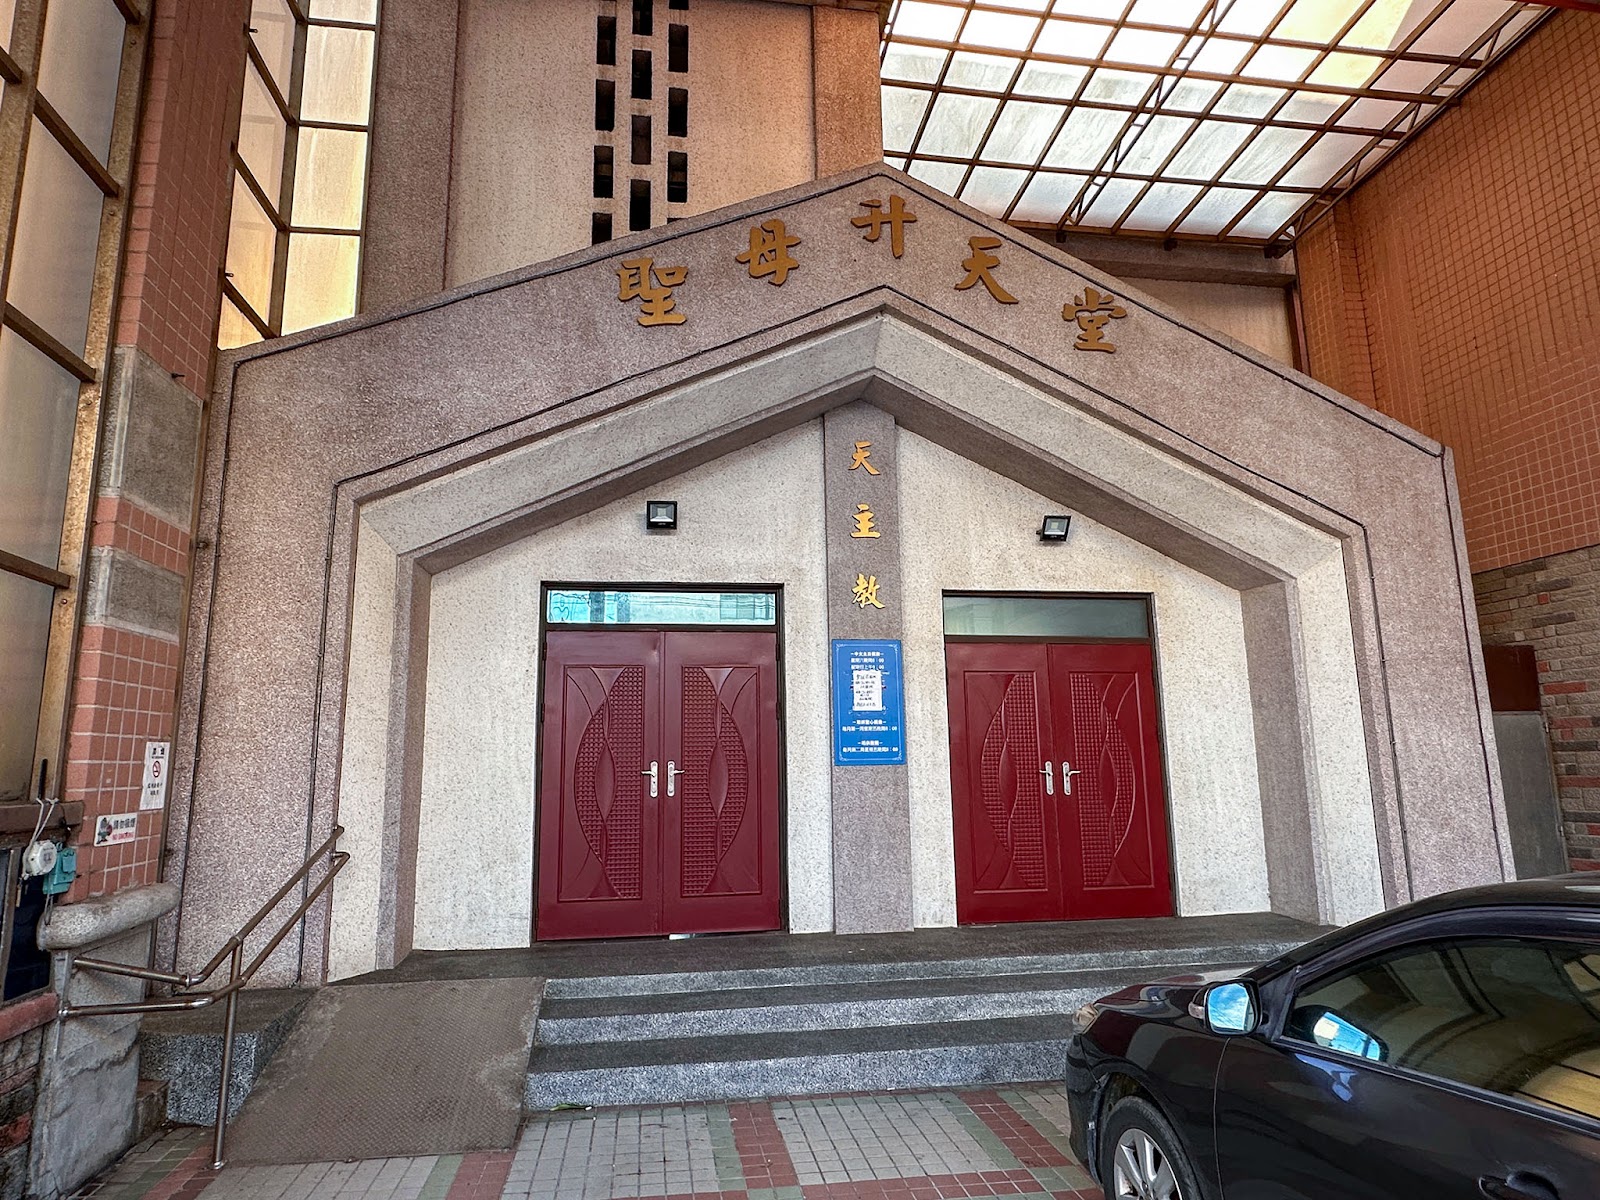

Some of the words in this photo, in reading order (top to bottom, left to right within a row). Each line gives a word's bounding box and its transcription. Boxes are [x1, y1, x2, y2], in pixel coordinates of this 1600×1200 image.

[616, 194, 1128, 353] 聖母升天堂
[849, 440, 886, 610] 天主教
